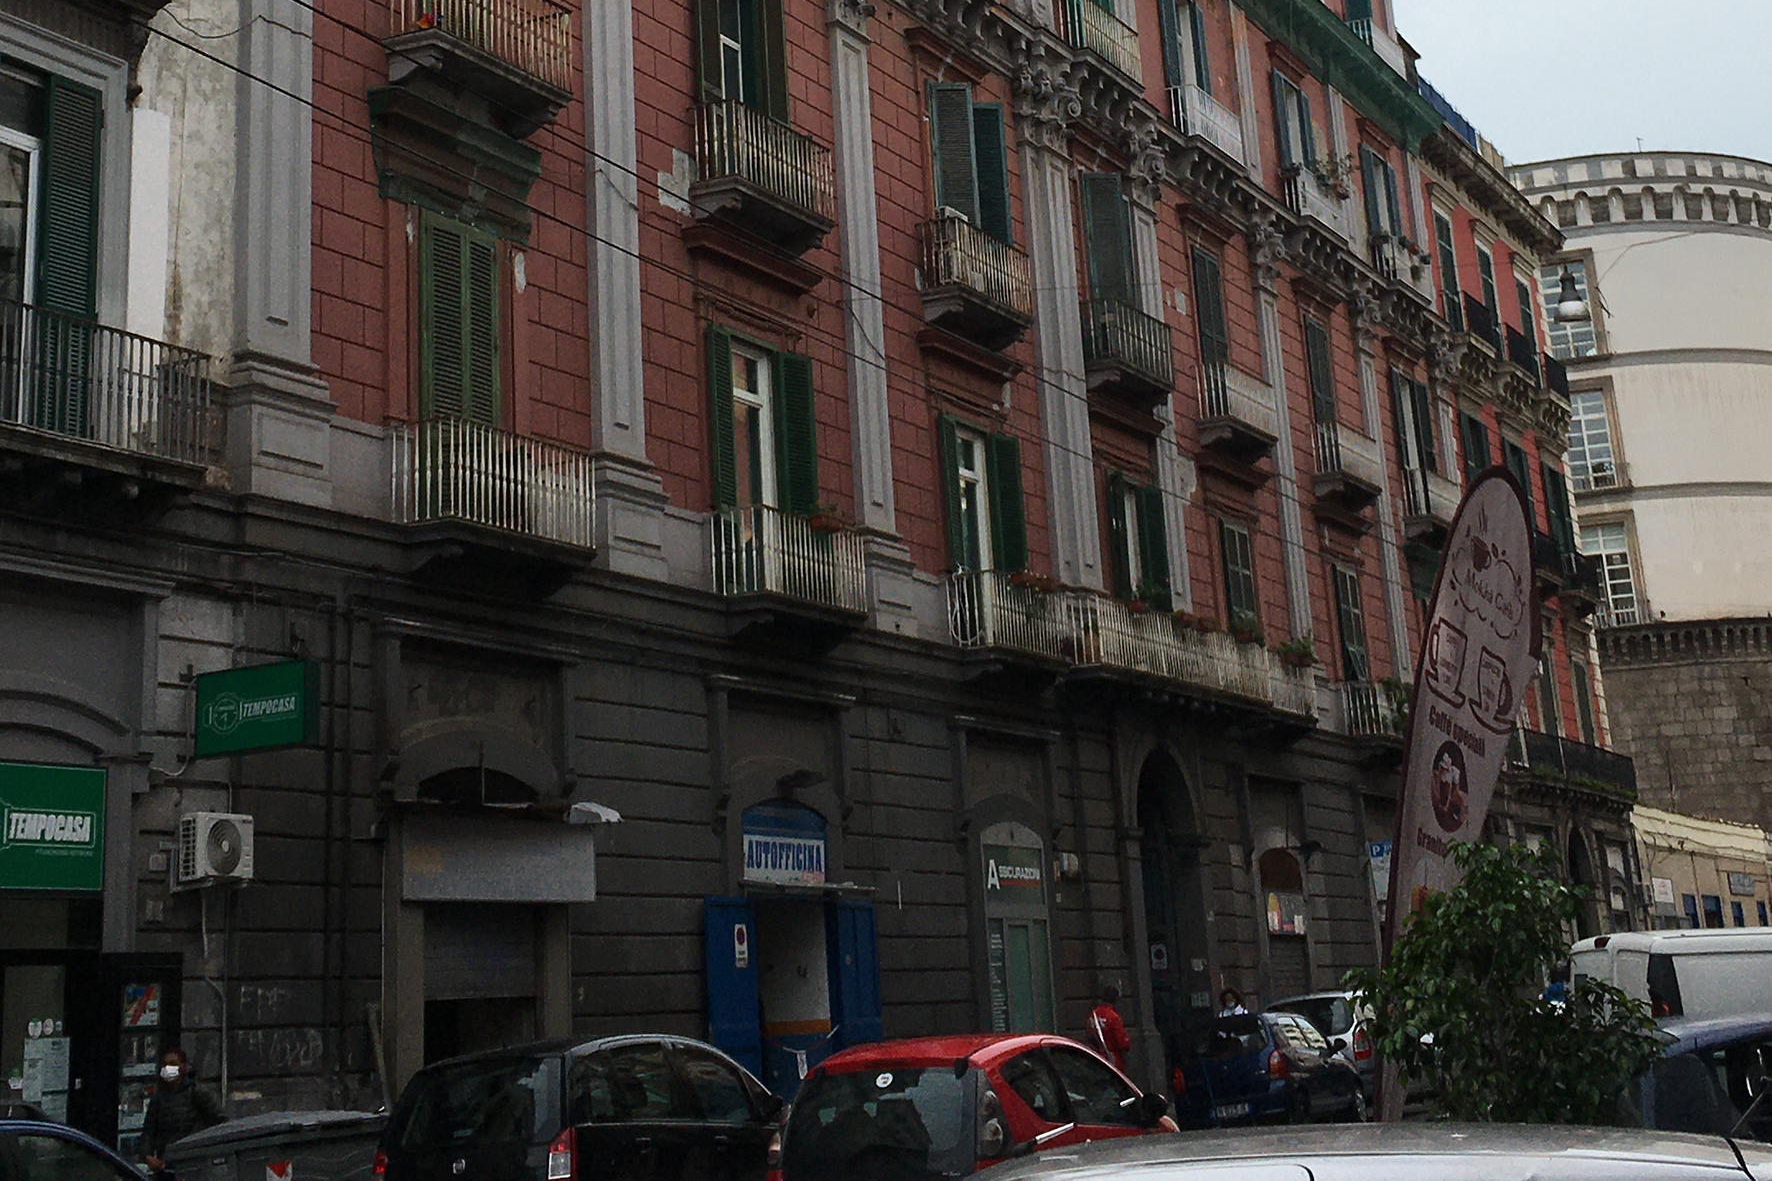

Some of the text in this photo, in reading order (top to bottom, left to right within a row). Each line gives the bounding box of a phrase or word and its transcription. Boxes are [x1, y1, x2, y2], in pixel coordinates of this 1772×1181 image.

[243, 696, 296, 717] TEMPOCASA
[8, 812, 91, 843] TEMPOCASA
[747, 839, 822, 872] AUTOFFICINA
